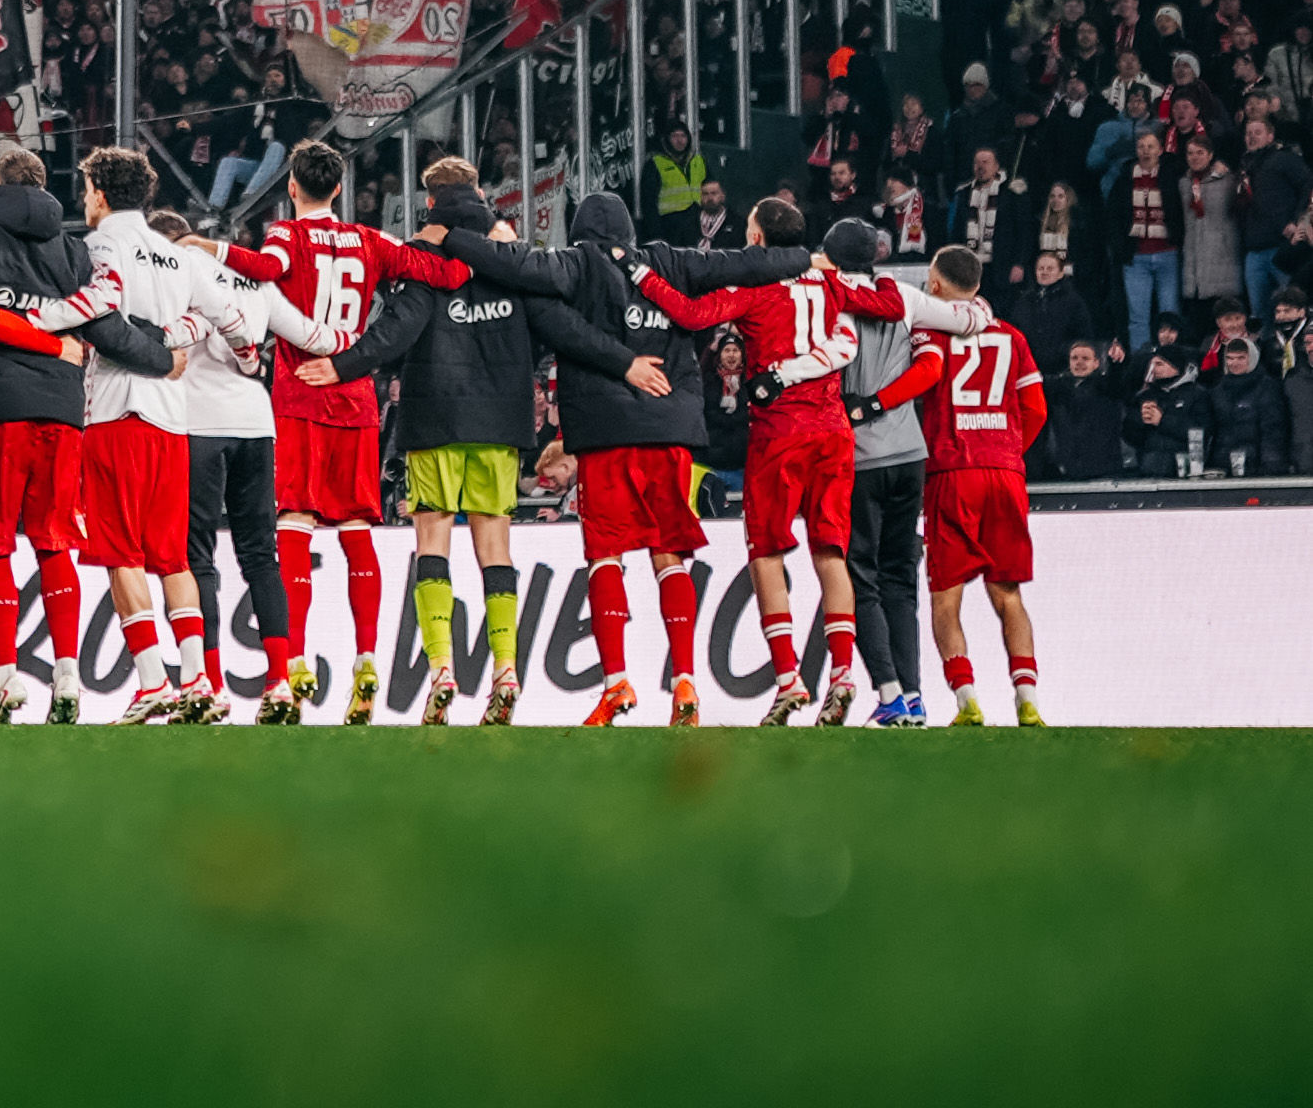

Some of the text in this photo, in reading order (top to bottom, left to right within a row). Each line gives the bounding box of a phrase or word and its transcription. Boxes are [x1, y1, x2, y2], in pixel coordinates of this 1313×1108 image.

[15, 292, 58, 310] JAK
[314, 254, 366, 332] 16
[467, 299, 513, 323] JAKO
[644, 310, 671, 330] JAK
[789, 285, 827, 355] 11
[951, 334, 1012, 407] 27
